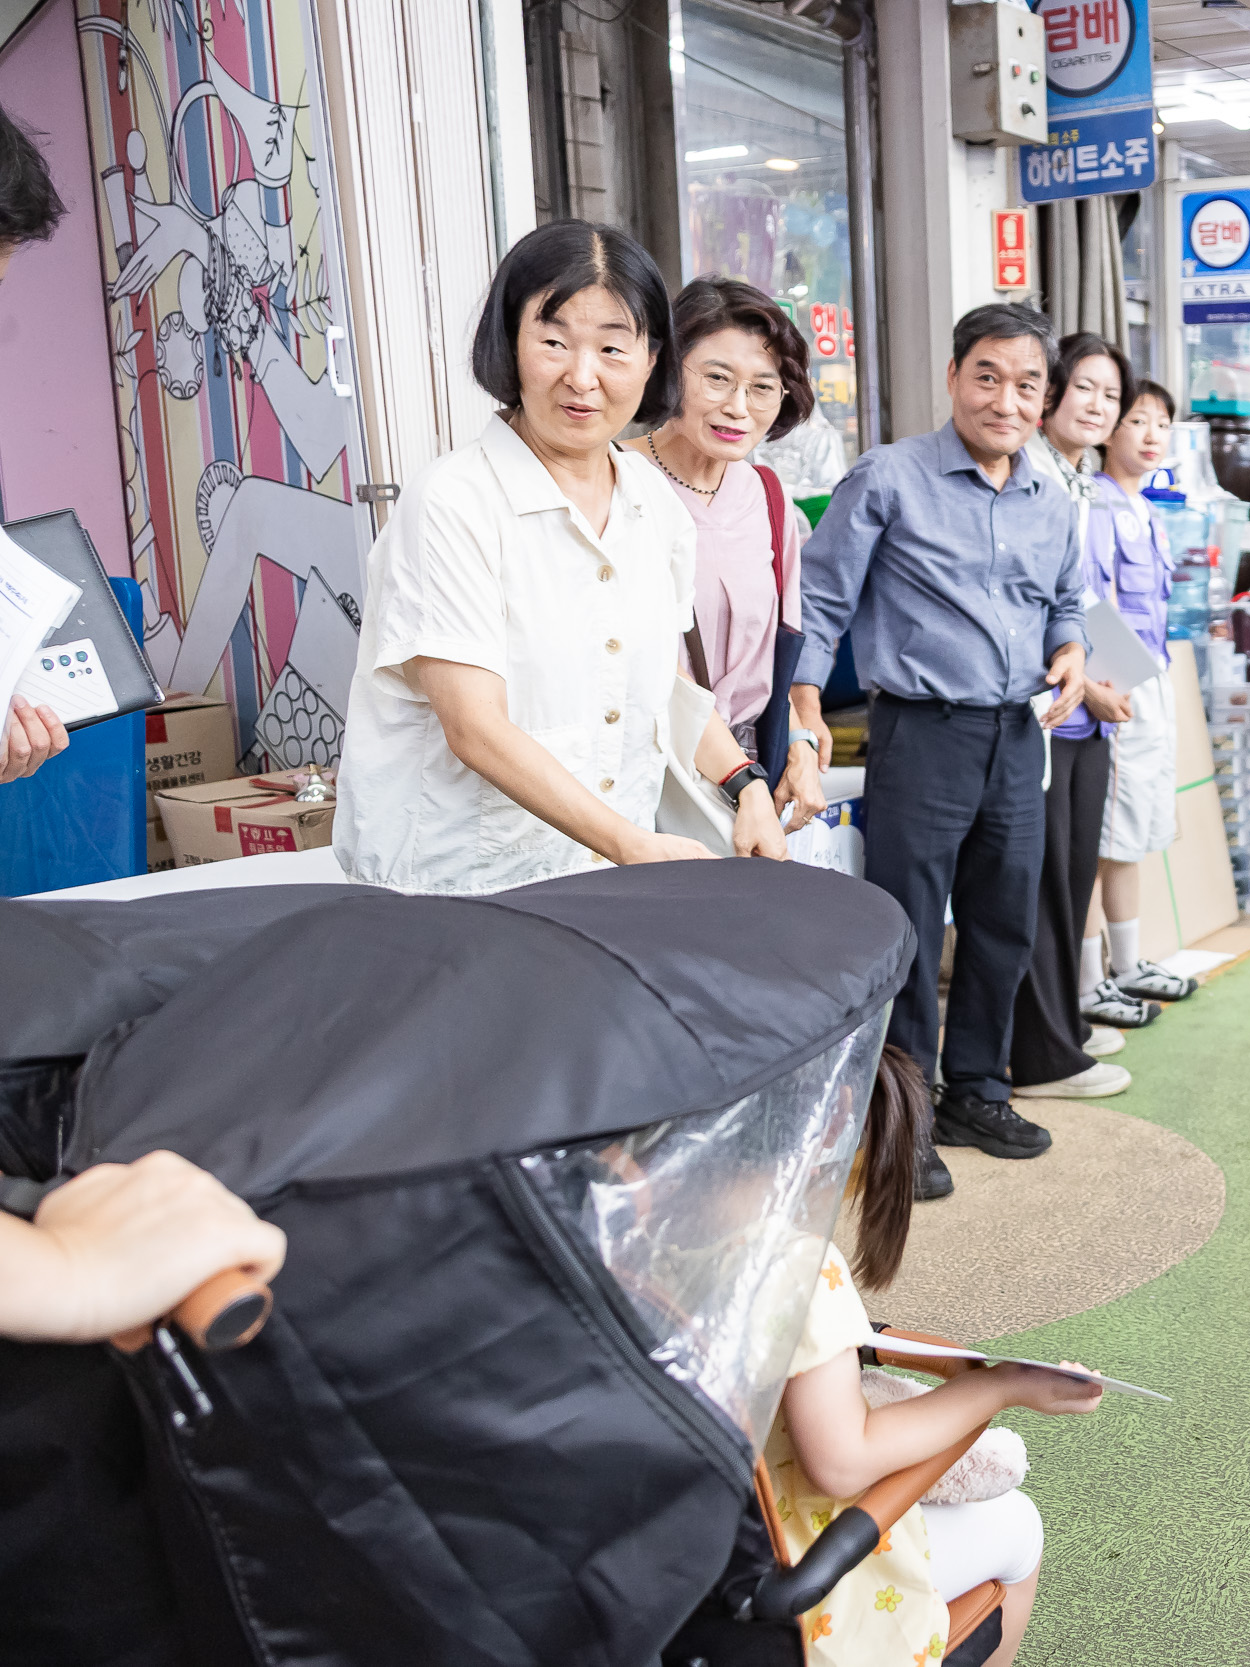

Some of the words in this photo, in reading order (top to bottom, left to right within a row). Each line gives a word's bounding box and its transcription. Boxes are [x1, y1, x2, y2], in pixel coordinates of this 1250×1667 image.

[1043, 0, 1121, 53] 담배
[1052, 51, 1113, 69] CIGARETTES
[1027, 137, 1150, 188] 하이트소주
[1198, 220, 1242, 245] 담배
[1194, 283, 1246, 297] KTRA
